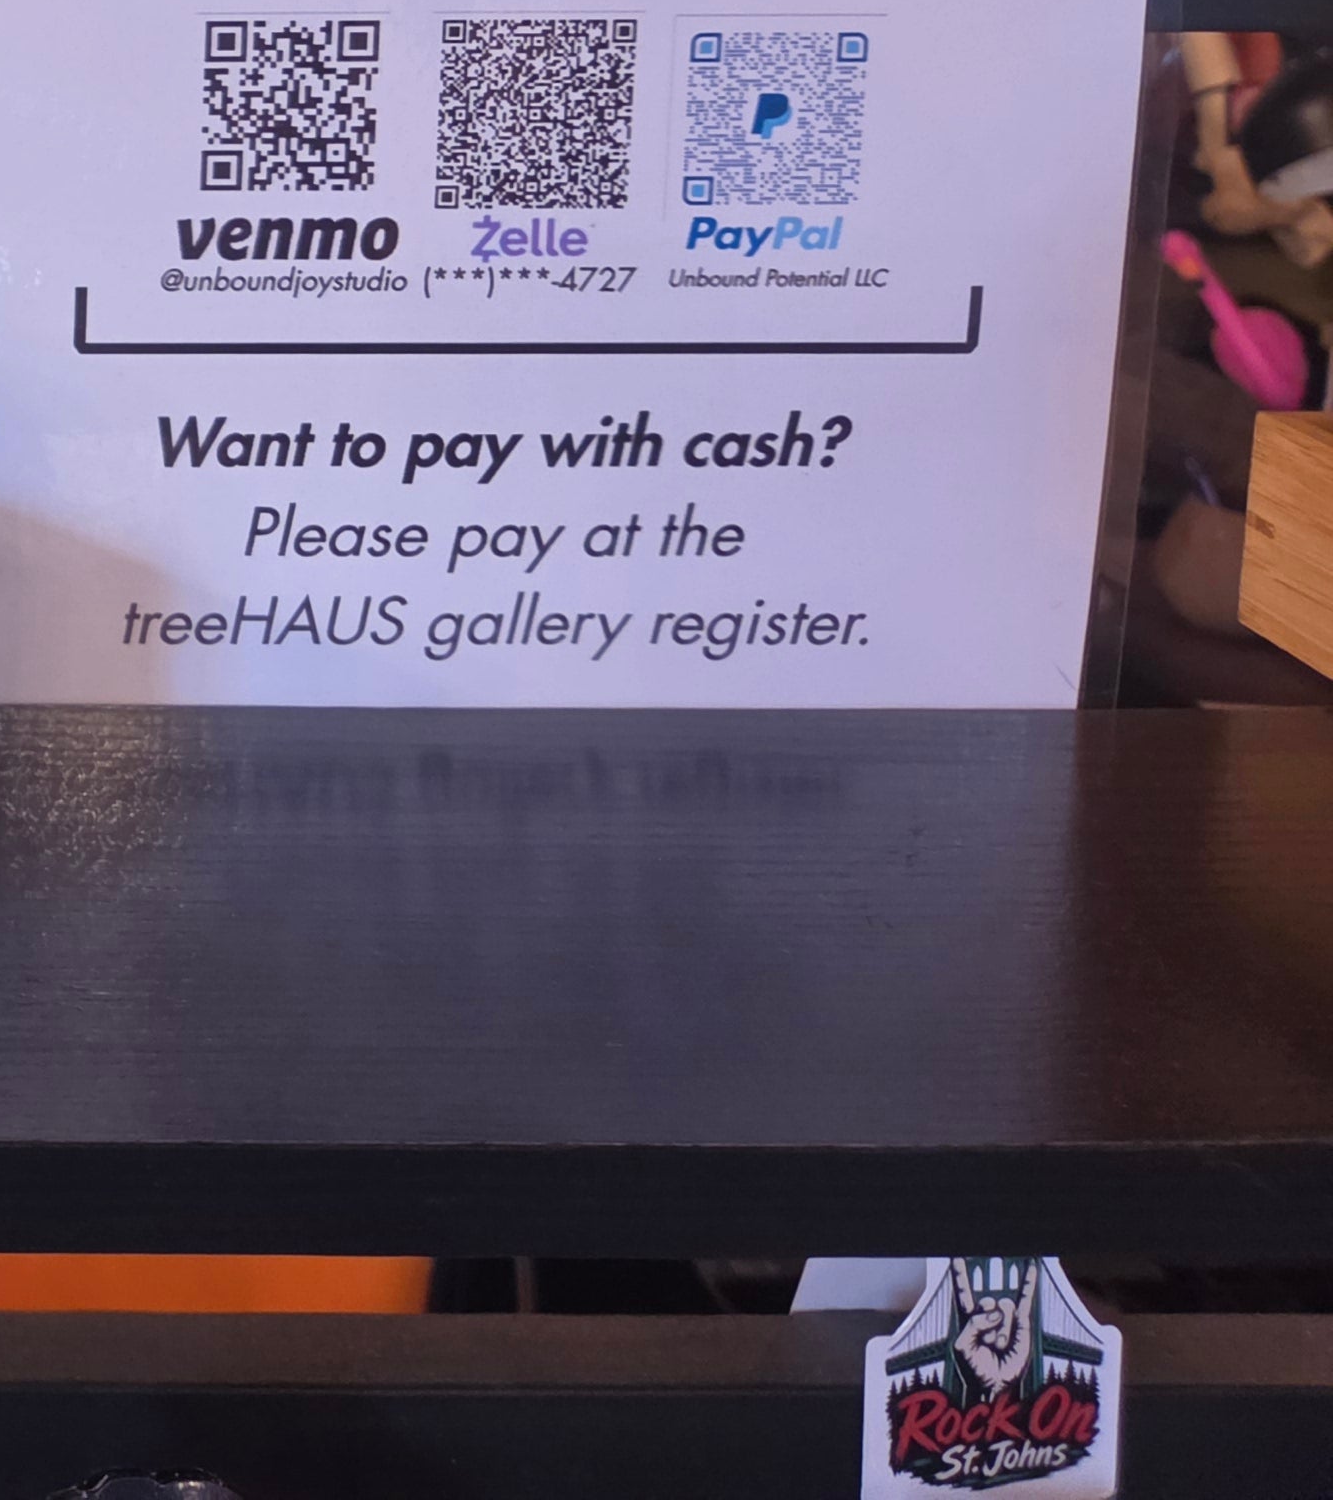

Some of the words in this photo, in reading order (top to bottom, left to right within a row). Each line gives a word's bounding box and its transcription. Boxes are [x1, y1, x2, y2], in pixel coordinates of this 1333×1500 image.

[177, 217, 399, 260] venmo
[471, 215, 589, 262] Zelle
[686, 216, 843, 257] PayPal
[160, 266, 408, 298] @unboundjoystudio
[668, 267, 761, 288] Unbound
[765, 267, 850, 288] Potential
[854, 268, 888, 288] LLC
[157, 417, 316, 469] Want
[330, 421, 389, 469] to
[401, 426, 520, 484] pay
[538, 413, 663, 468] with
[682, 412, 854, 469] cash?
[244, 505, 429, 559] Please
[447, 520, 564, 575] pay
[582, 511, 642, 558] at
[658, 504, 746, 559] the
[121, 598, 407, 651] treeHAUS
[424, 594, 631, 661] gallery
[647, 600, 873, 661] register.
[897, 1389, 1025, 1461] Rock
[1029, 1386, 1097, 1441] On
[935, 1444, 979, 1480] St.
[982, 1440, 1069, 1477] Johns
